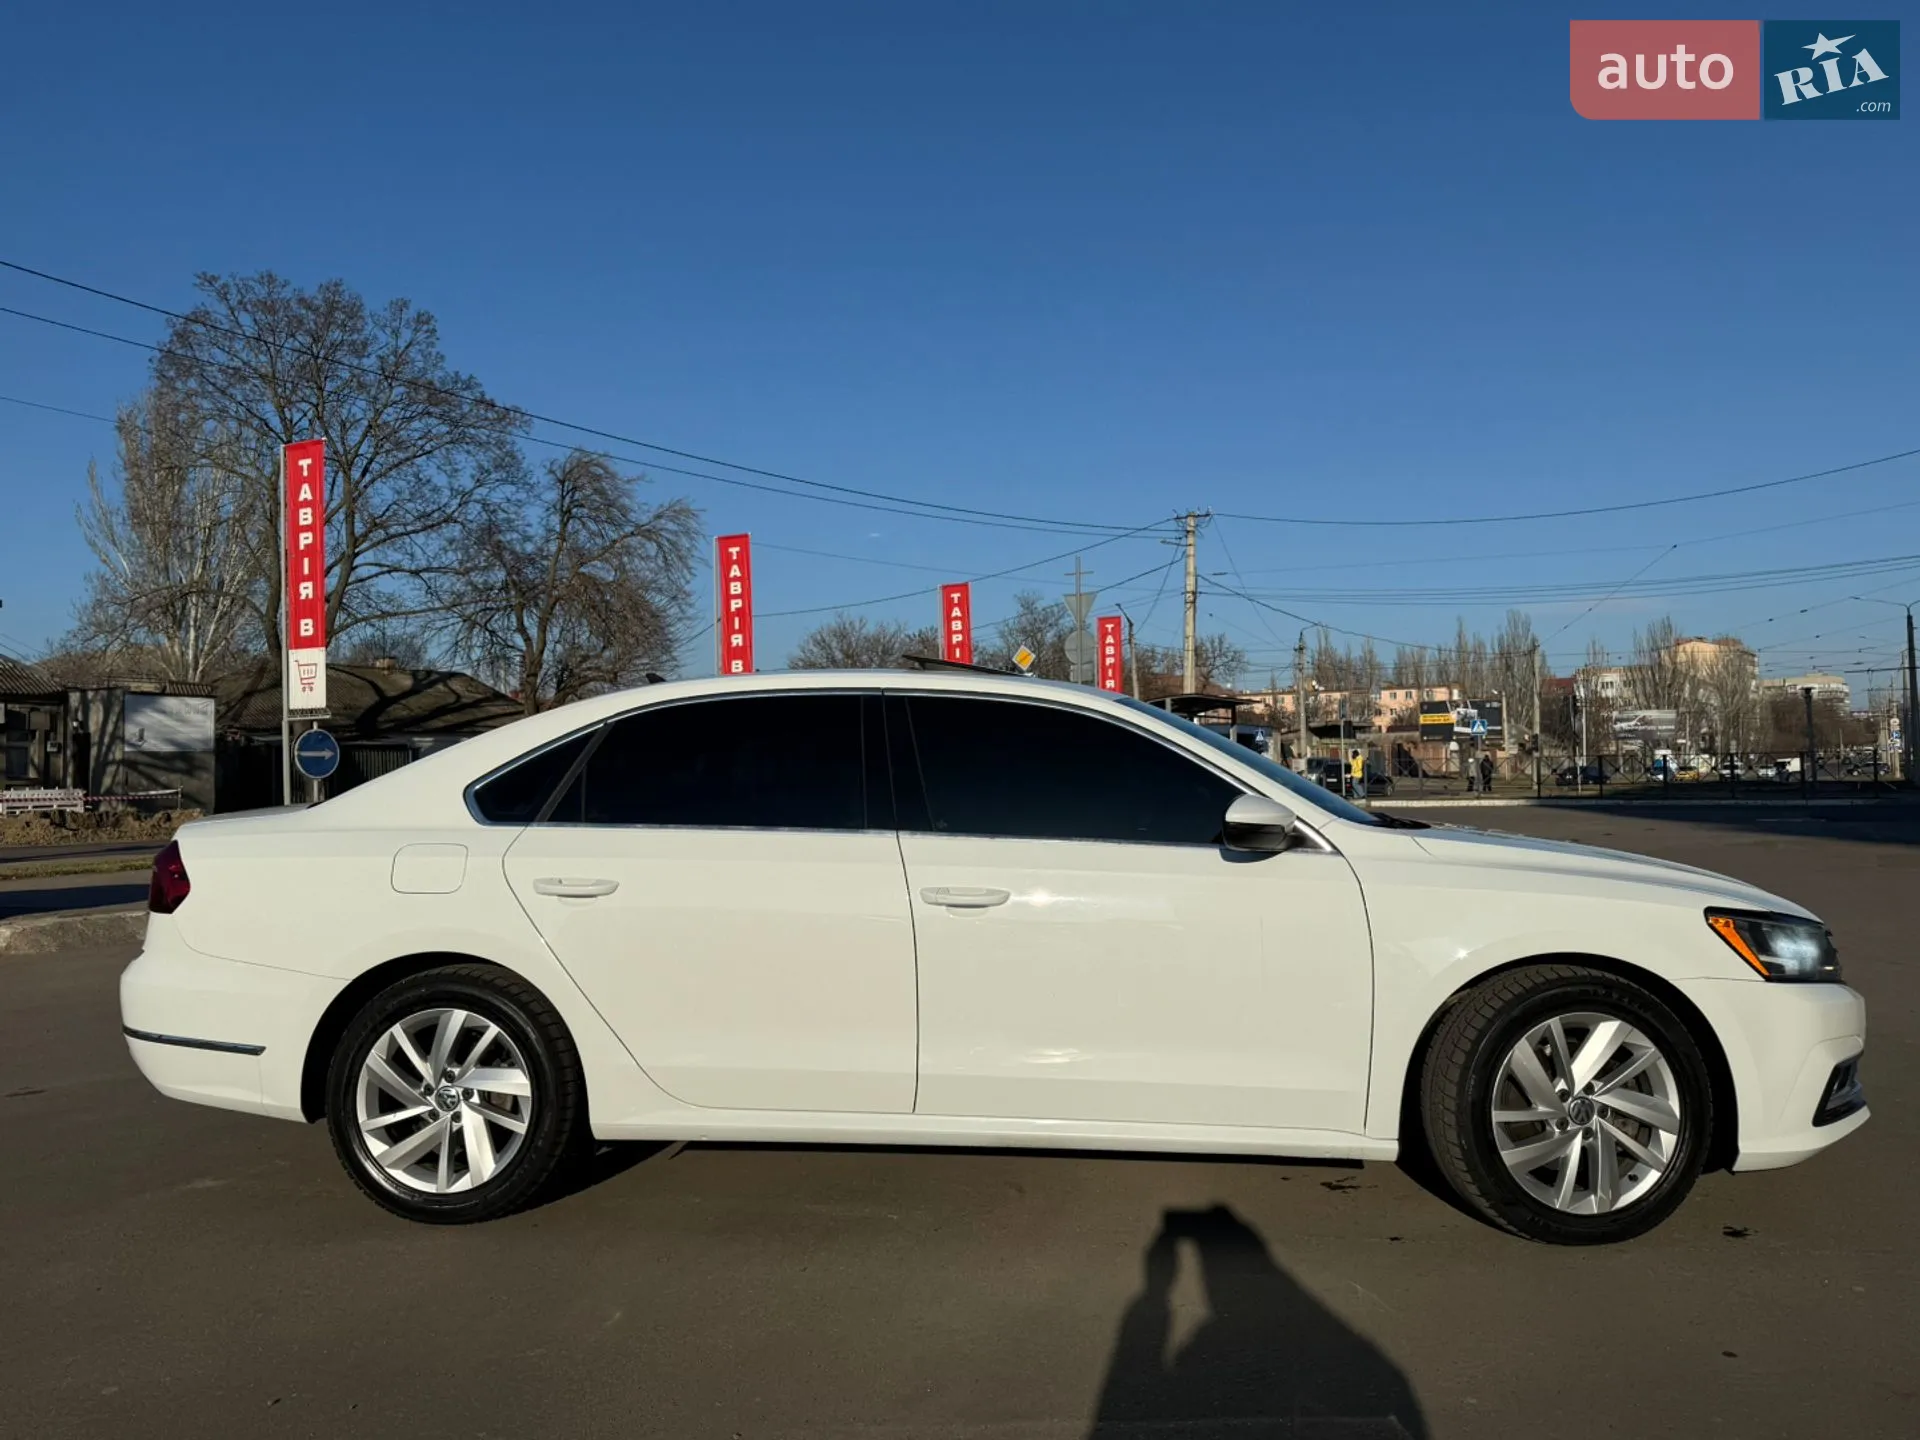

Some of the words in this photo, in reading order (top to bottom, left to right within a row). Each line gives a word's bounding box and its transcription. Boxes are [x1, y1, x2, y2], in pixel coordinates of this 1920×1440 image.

[298, 458, 314, 600] ТАВРІЯ
[299, 618, 314, 637] В
[728, 547, 743, 647] ТАВРІЯ
[950, 592, 963, 659] ТАВРІ
[731, 659, 744, 673] В
[1105, 623, 1116, 689] ТАВРІЯ
